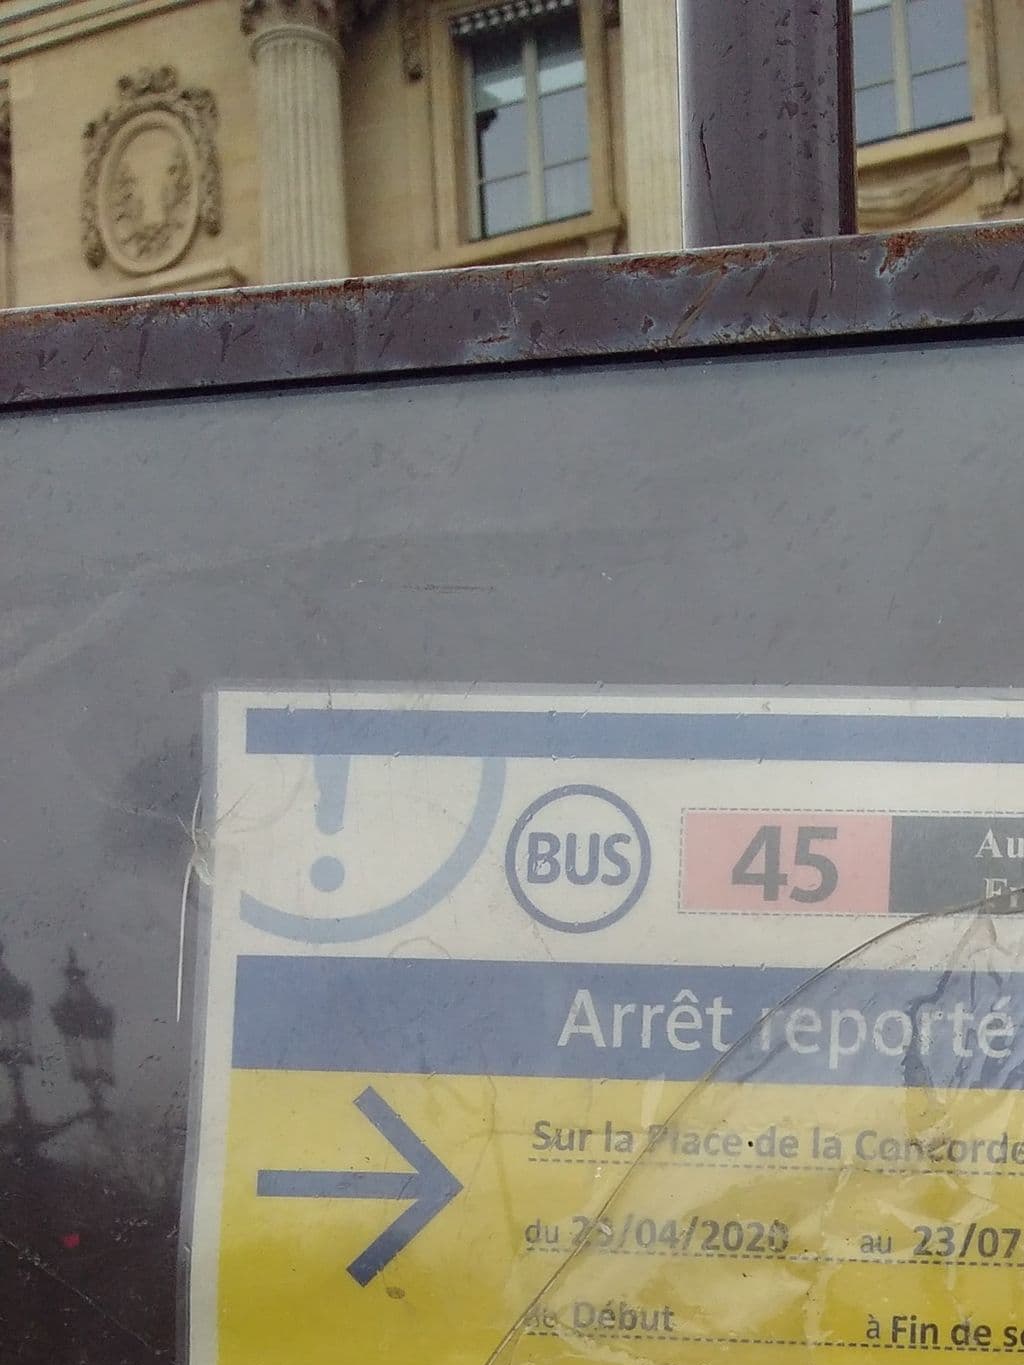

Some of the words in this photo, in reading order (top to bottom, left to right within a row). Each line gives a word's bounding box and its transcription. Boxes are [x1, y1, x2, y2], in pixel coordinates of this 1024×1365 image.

[526, 831, 633, 887] BUS
[731, 825, 840, 904] 45
[556, 988, 734, 1053] Arrêt
[759, 995, 1018, 1070] reporté
[532, 1119, 593, 1152] Sur
[604, 1120, 635, 1153] la
[755, 1126, 800, 1159] de
[812, 1126, 843, 1160] la
[524, 1218, 560, 1245] du
[860, 1233, 893, 1255] au
[573, 1301, 676, 1333] Début
[866, 1313, 881, 1340] à
[892, 1315, 939, 1346] Fin
[951, 1317, 992, 1347] de
